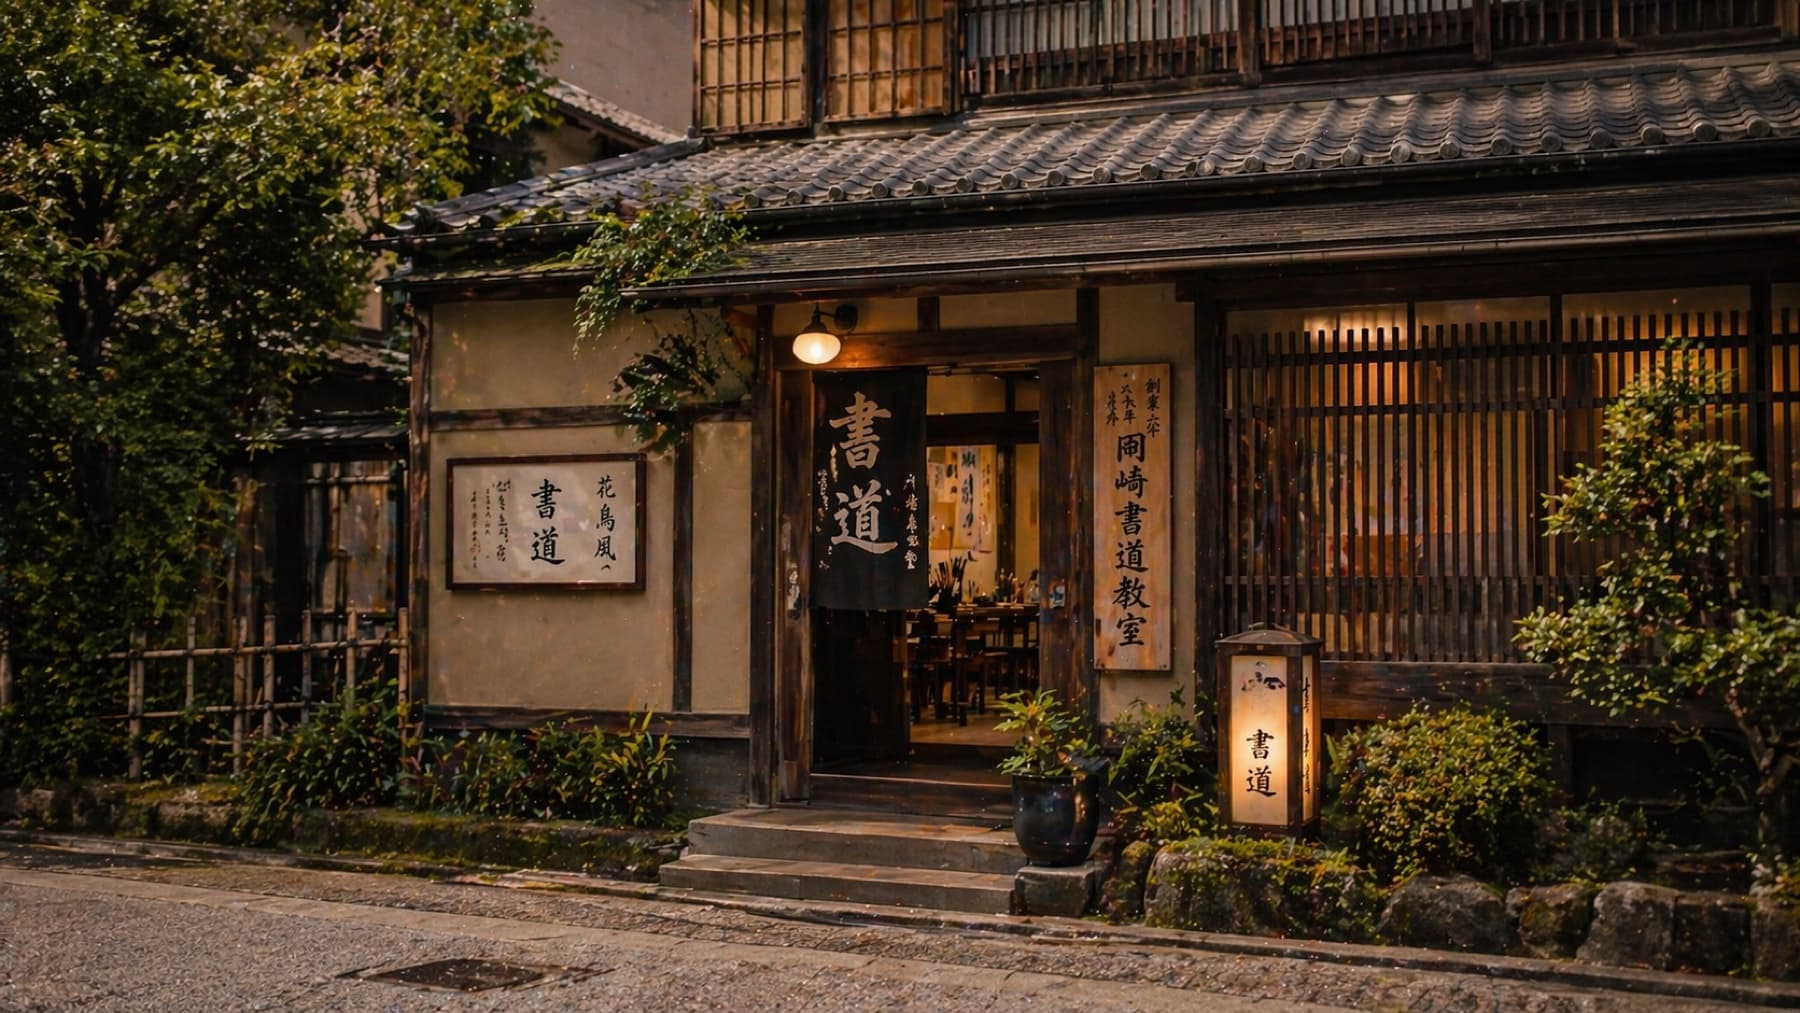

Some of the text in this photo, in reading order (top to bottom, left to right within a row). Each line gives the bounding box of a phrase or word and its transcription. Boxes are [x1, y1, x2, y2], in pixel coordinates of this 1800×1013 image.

[829, 391, 899, 554] 書道
[530, 478, 566, 565] 書道
[1246, 729, 1277, 798] 書道
